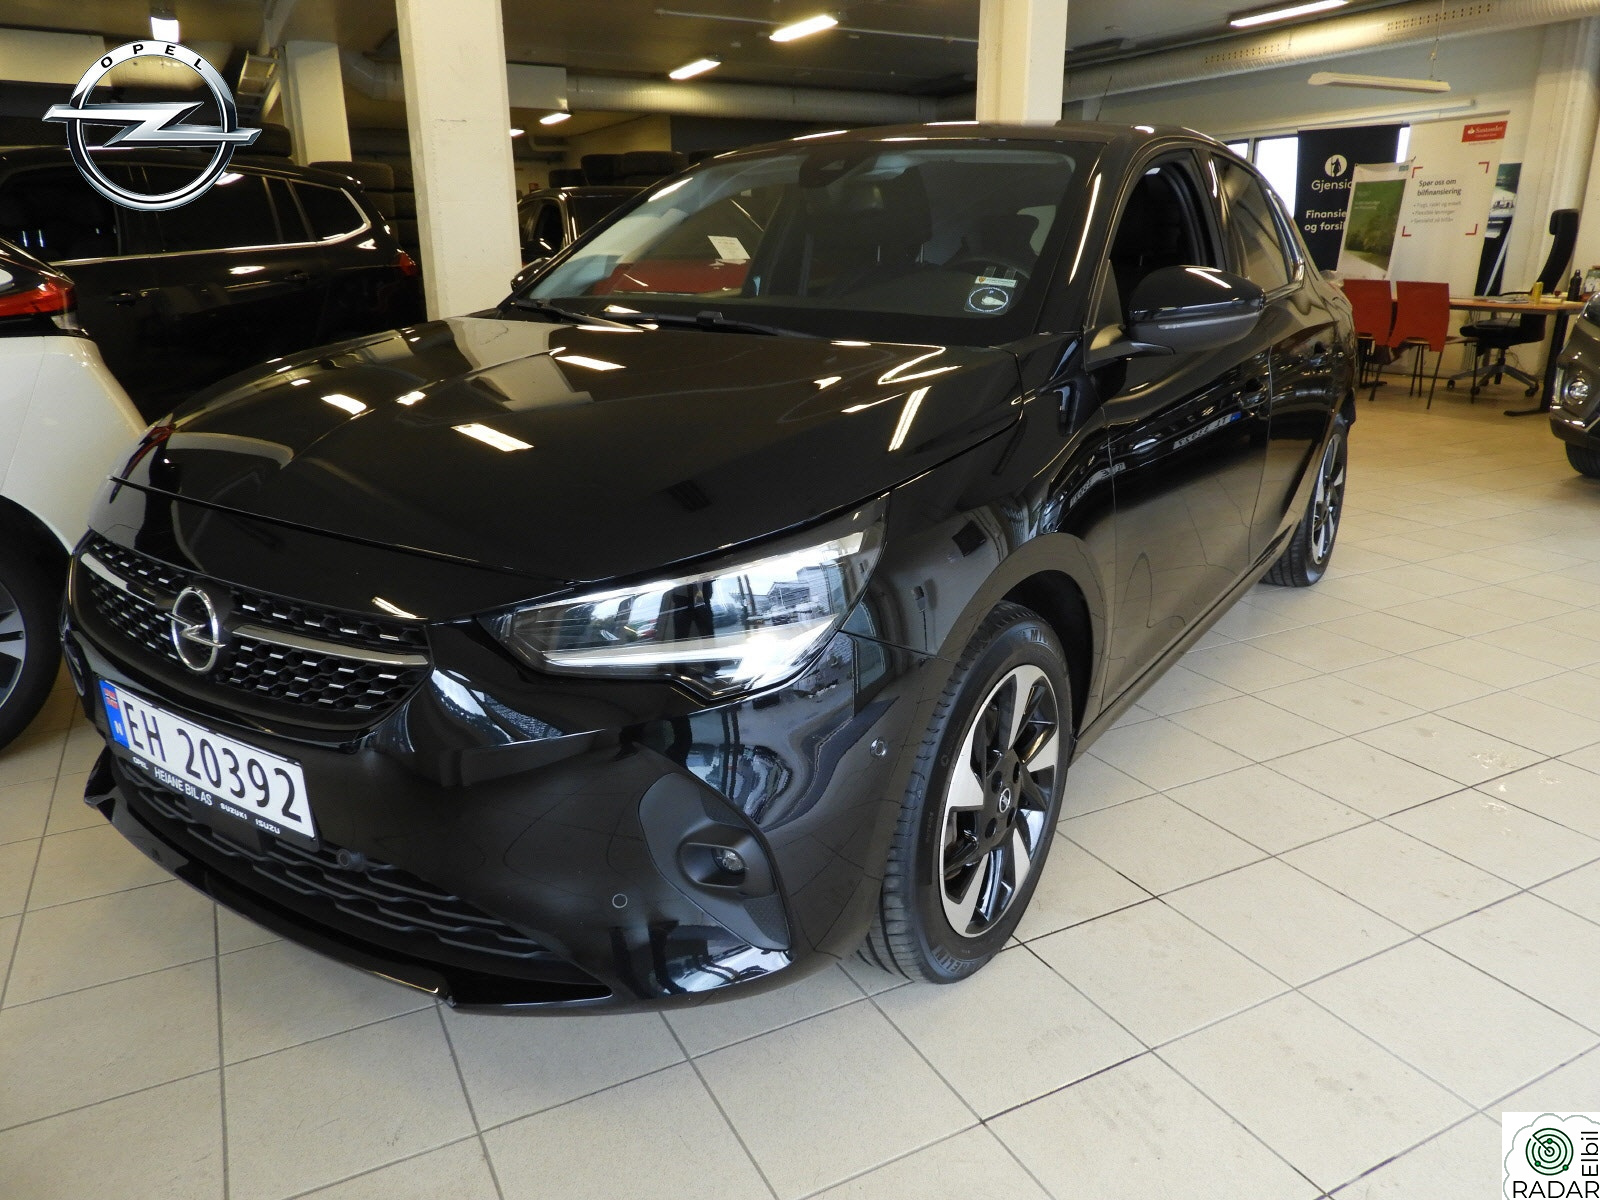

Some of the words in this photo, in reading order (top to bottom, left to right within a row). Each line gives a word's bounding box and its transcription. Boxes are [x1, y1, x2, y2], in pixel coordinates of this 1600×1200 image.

[1419, 180, 1433, 188] Spør
[1417, 188, 1462, 196] bilfinansiering
[1304, 223, 1317, 233] og
[123, 700, 168, 763] EH
[176, 727, 303, 824] 20392
[154, 766, 184, 792] HEIANE
[184, 783, 200, 800] BIL
[200, 793, 213, 806] AS
[220, 802, 248, 820] SUZUKI
[255, 818, 281, 835] ISUZU
